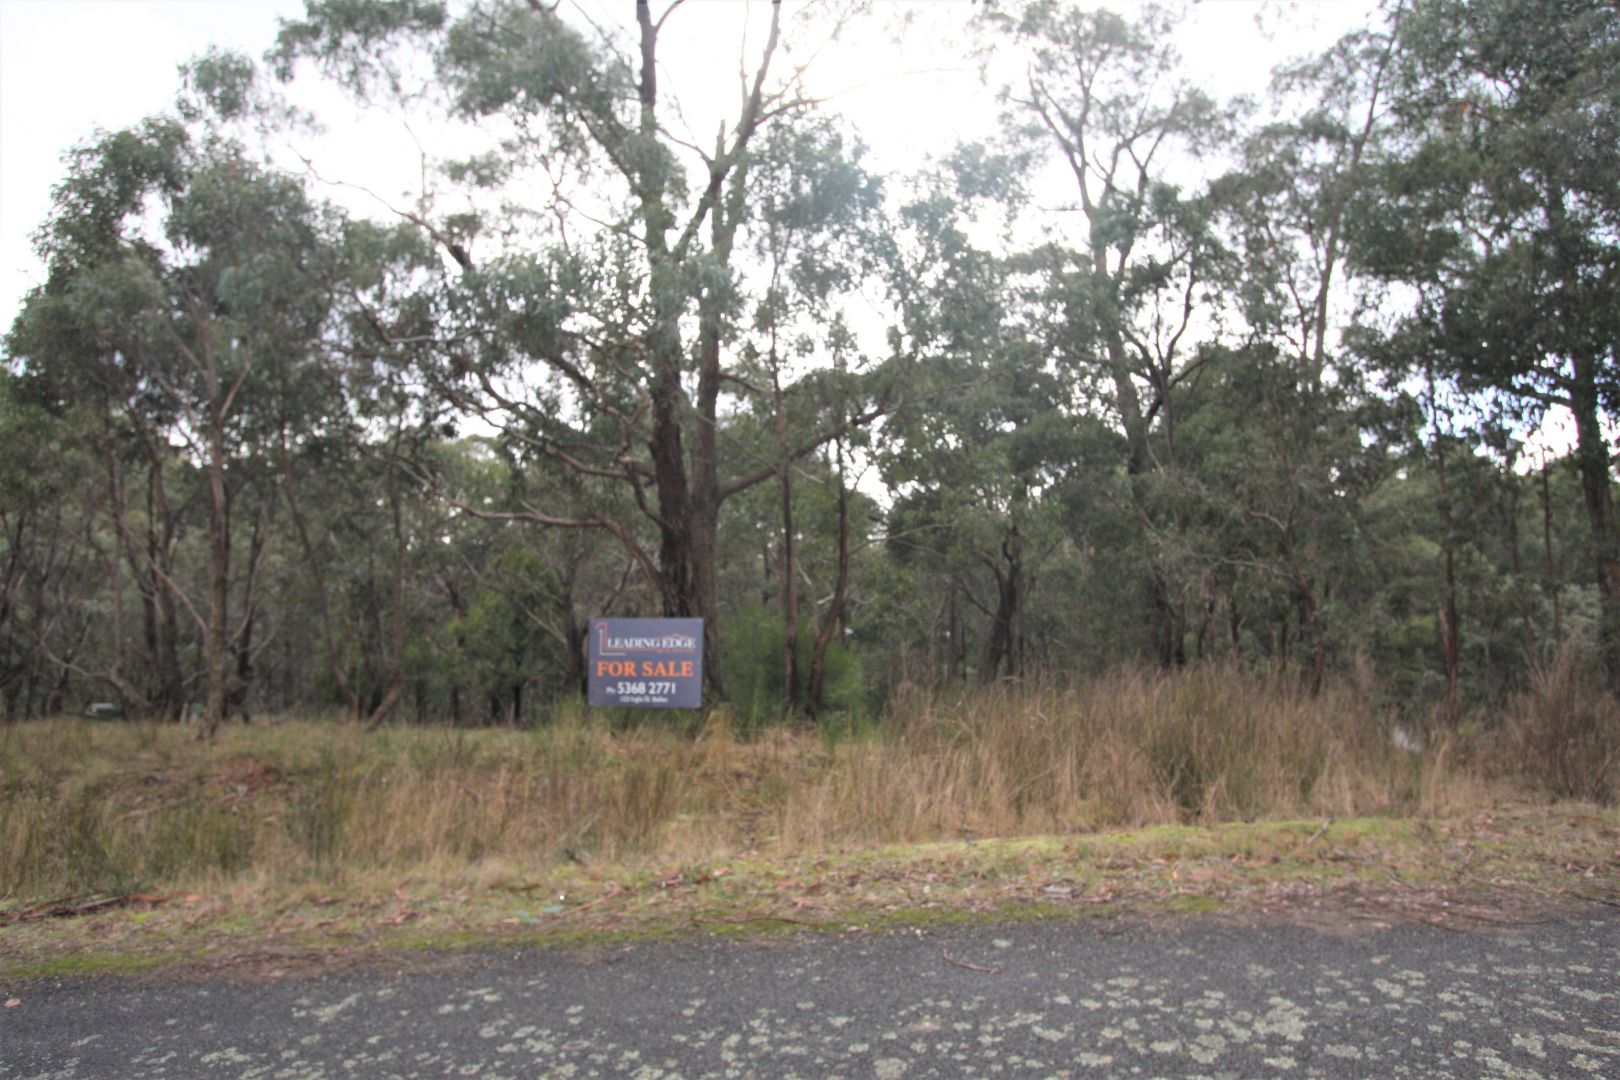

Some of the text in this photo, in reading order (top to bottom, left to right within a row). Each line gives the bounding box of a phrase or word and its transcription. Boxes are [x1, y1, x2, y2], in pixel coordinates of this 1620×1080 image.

[607, 637, 696, 648] LEADING EDGE
[597, 661, 693, 677] FOR SALE
[617, 682, 645, 694] 5368
[648, 682, 676, 694] 2771
